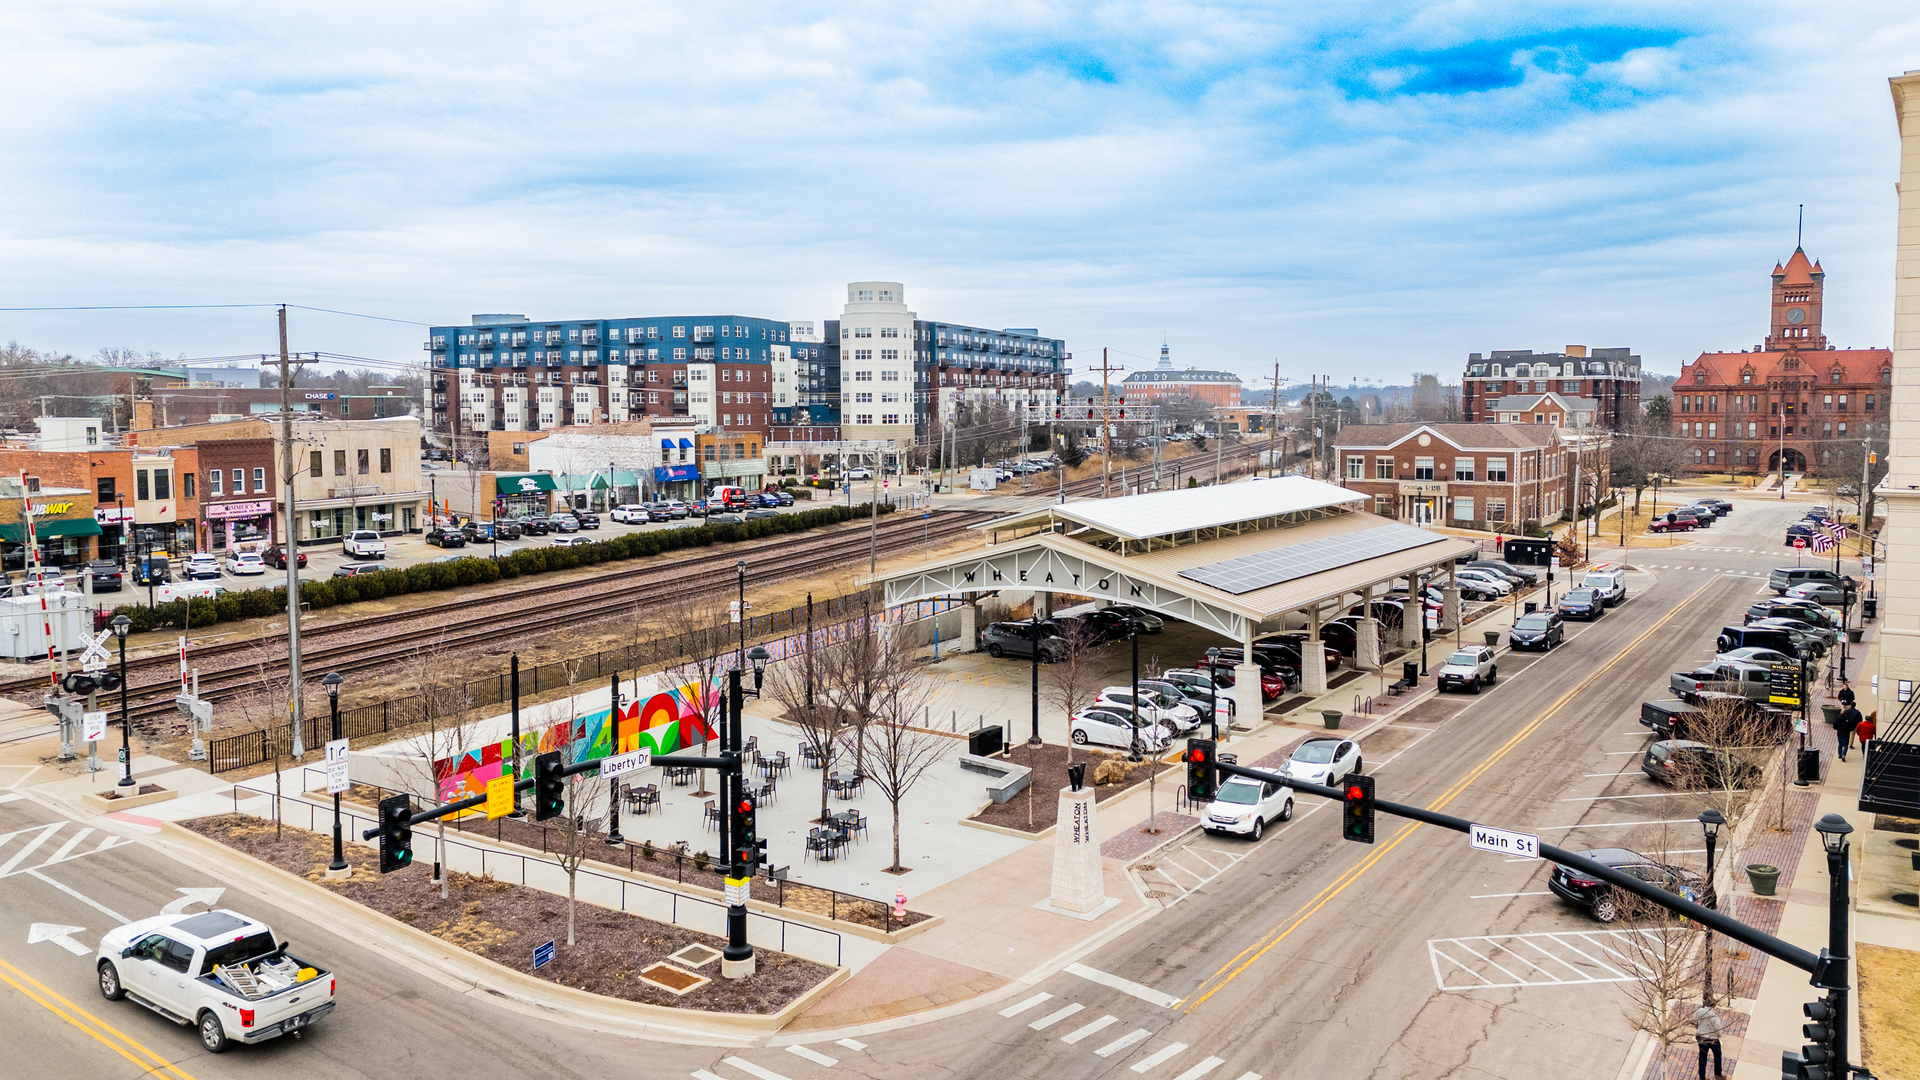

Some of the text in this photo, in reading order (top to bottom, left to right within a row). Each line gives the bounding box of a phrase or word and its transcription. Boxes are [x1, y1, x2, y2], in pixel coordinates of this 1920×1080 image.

[26, 502, 73, 516] UBWAY
[964, 570, 1141, 597] WHEATON
[603, 753, 649, 774] Liberty Dr
[331, 771, 345, 779] STOP
[329, 782, 348, 790] TRACKS
[1073, 802, 1081, 845] WHEATON
[1476, 832, 1532, 852] Main St
